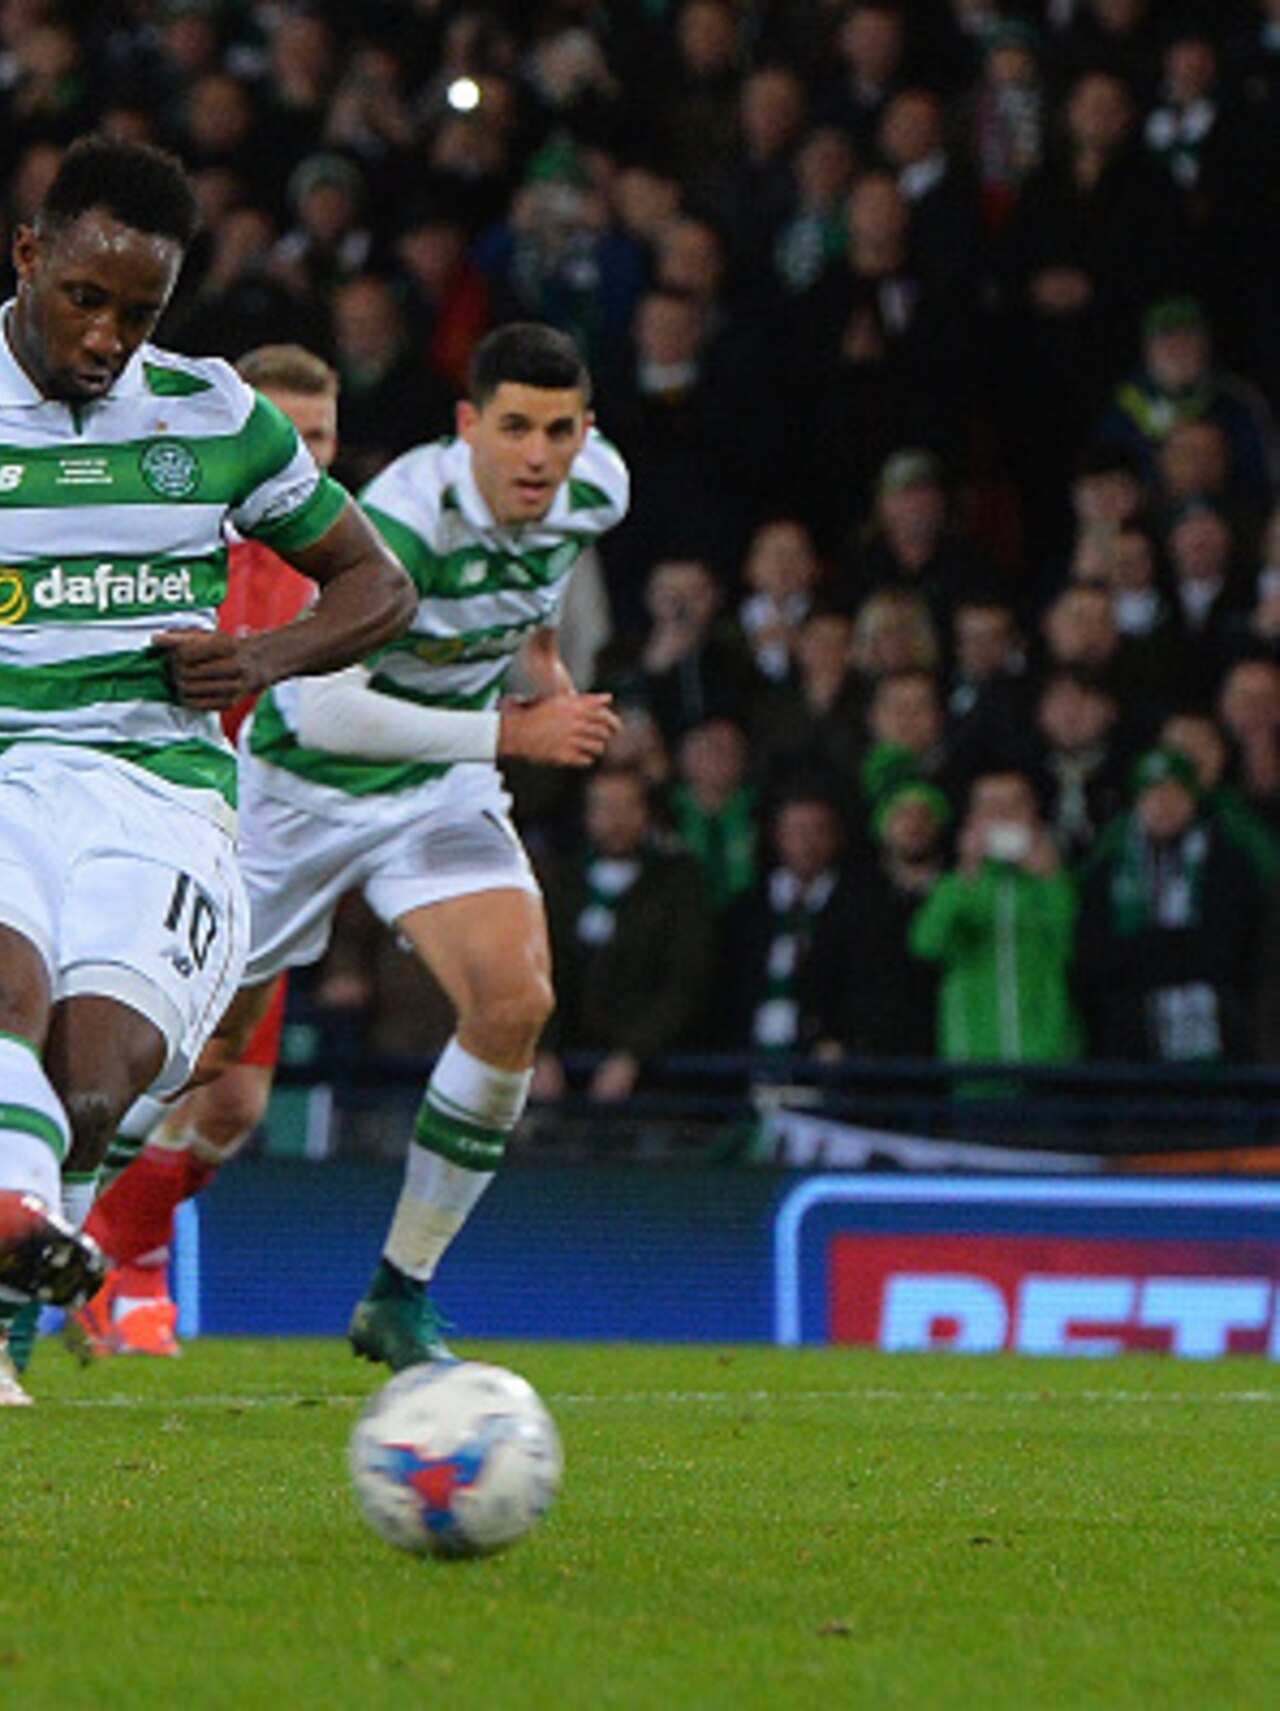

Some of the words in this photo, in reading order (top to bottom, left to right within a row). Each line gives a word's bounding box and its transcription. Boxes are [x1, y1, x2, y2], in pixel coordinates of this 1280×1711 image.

[33, 563, 195, 612] dafabet
[163, 870, 217, 970] 10
[880, 1275, 1280, 1359] BET
